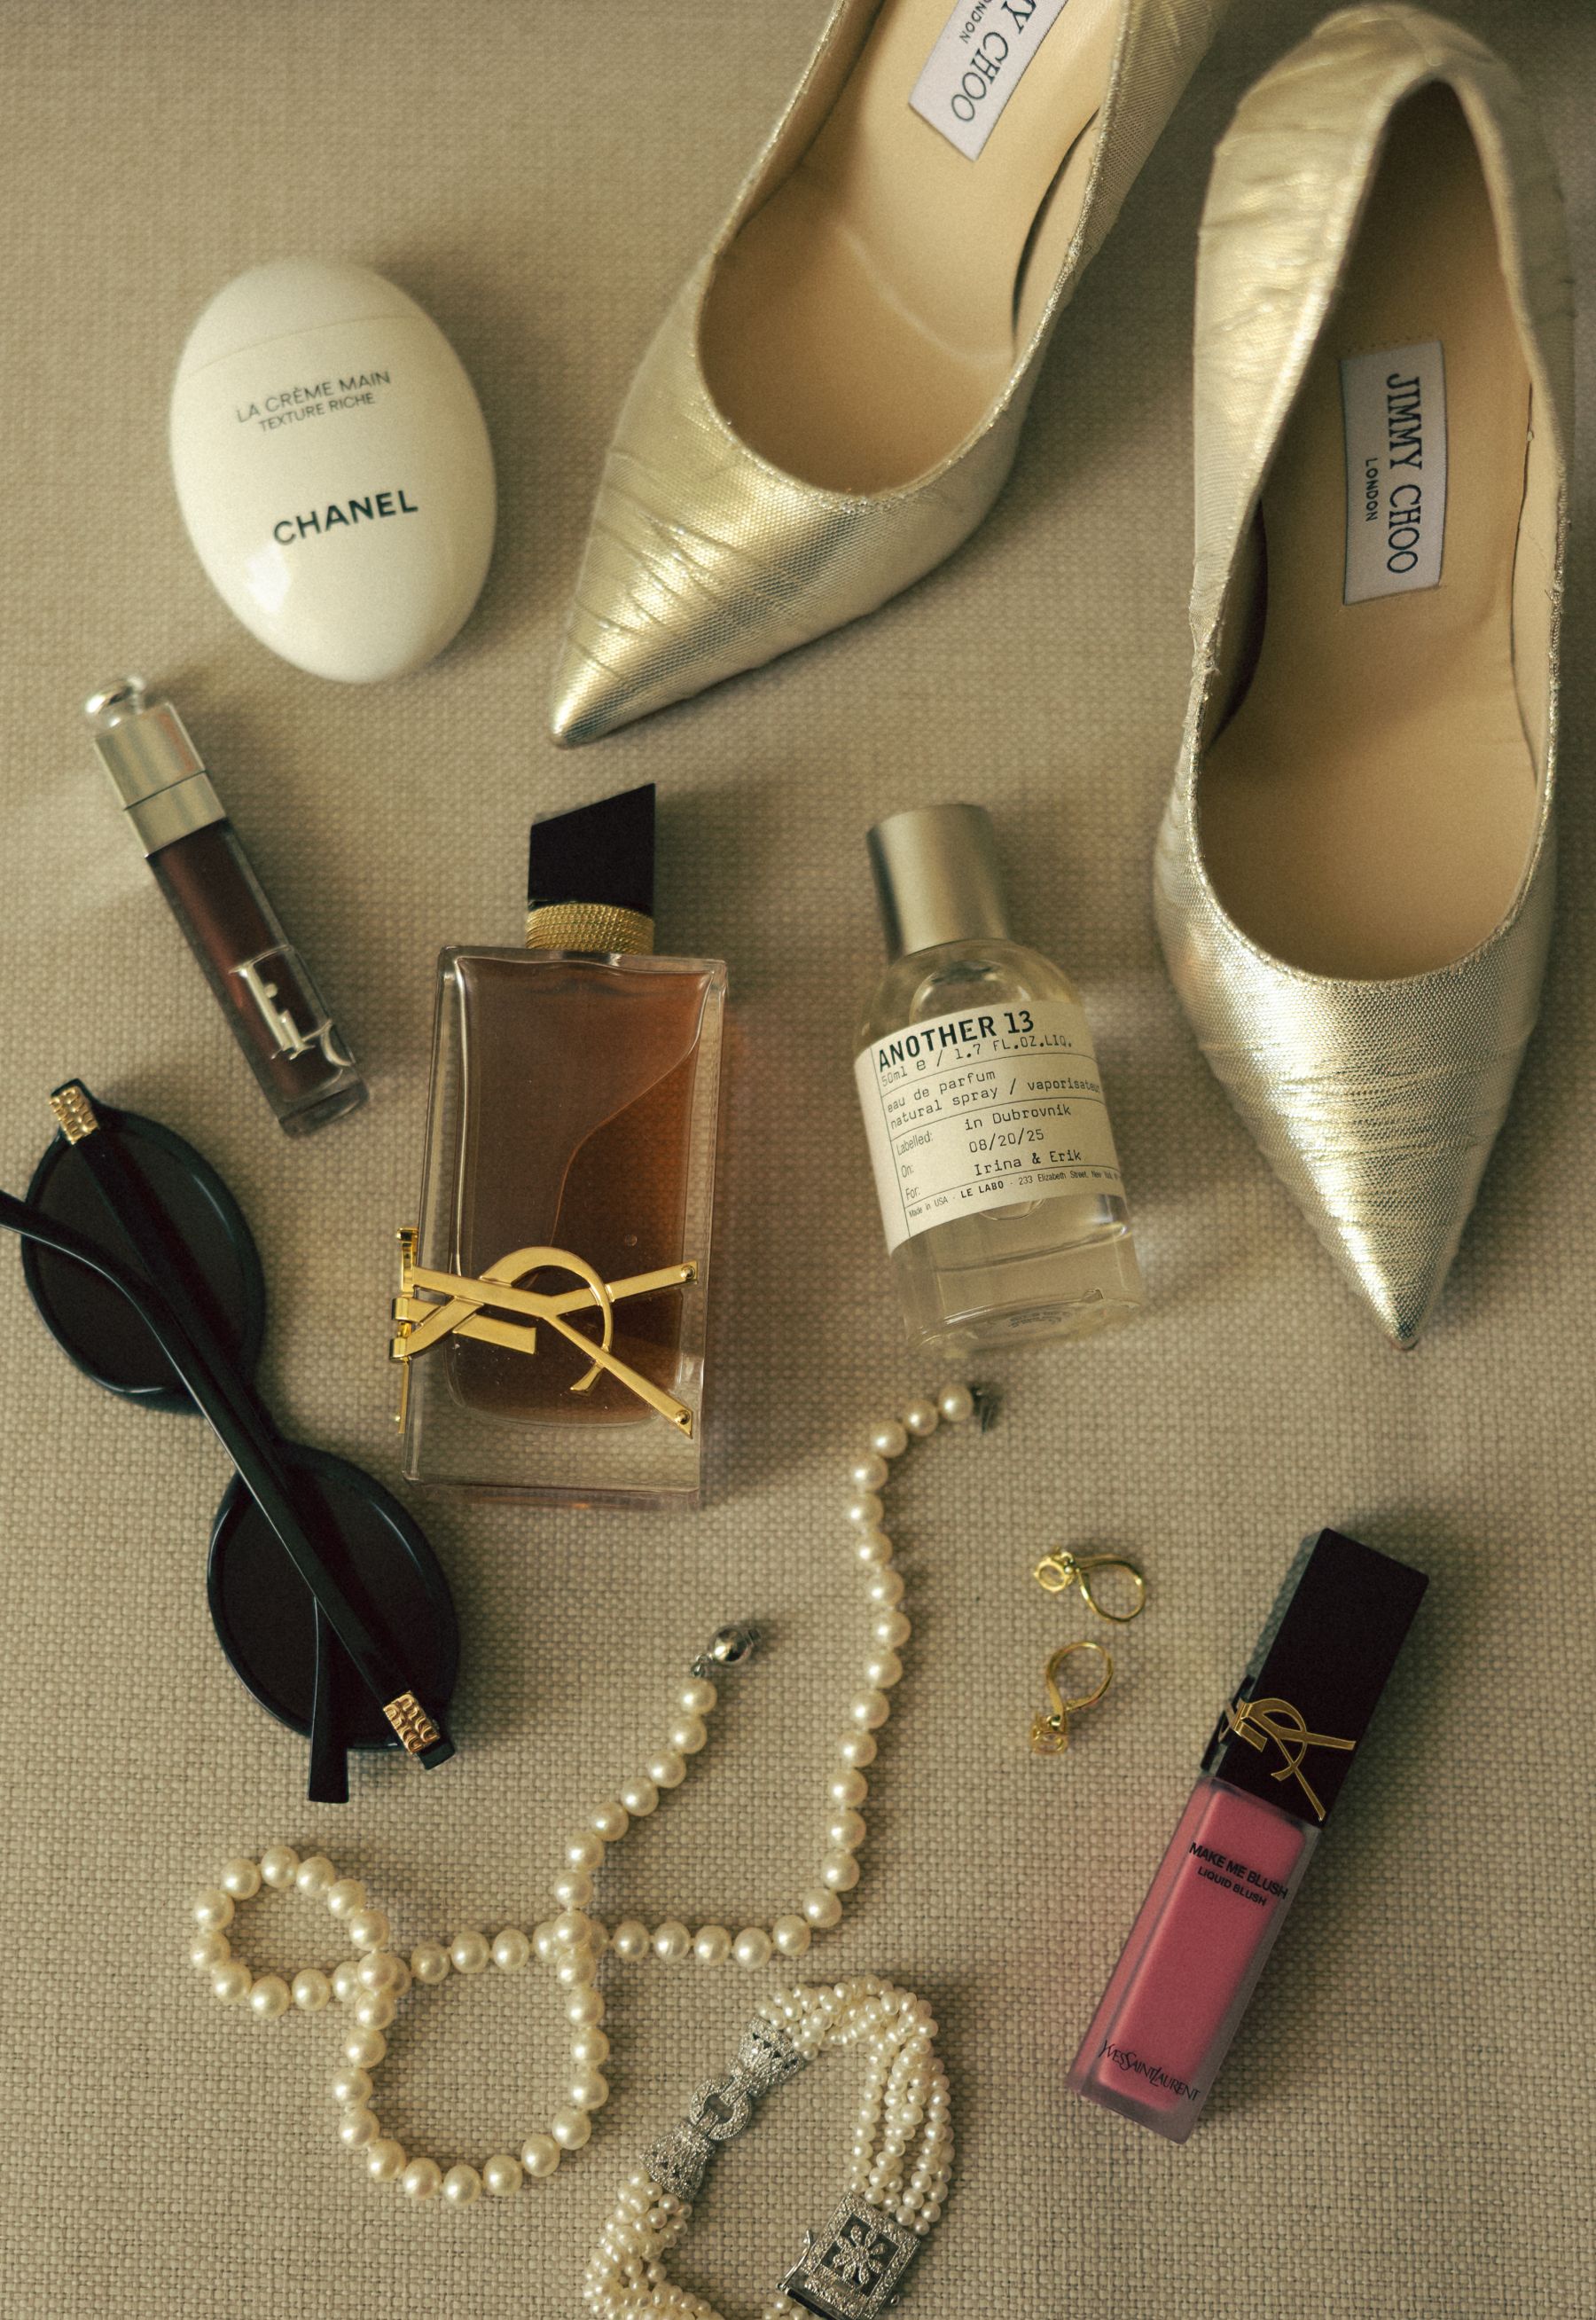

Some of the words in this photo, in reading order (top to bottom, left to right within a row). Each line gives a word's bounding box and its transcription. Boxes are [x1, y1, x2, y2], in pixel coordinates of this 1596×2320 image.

[951, 32, 1009, 121] CHOO
[237, 404, 262, 423] LA
[266, 381, 334, 412] CRÈME
[339, 371, 391, 393] MAIN
[259, 404, 325, 432] TEXTURE
[329, 392, 376, 412] RICHE
[1386, 372, 1422, 469] JIMMY
[1365, 458, 1379, 521] LONDON
[273, 490, 419, 545] CHANEL
[1387, 484, 1421, 573] CHOO
[879, 1016, 997, 1072] ANOTHER
[1004, 1010, 1034, 1033] 13
[881, 1066, 908, 1087] 50ml
[955, 1043, 981, 1060] 1.7
[888, 1097, 905, 1113] eau
[913, 1088, 929, 1101] de
[939, 1070, 996, 1094] parfum
[890, 1100, 942, 1130] natural
[952, 1087, 998, 1106] spray
[896, 1130, 933, 1156] Labelled:
[965, 1118, 982, 1131] in
[992, 1104, 1071, 1124] Dubrovnik
[901, 1164, 914, 1178] On:
[969, 1128, 1044, 1153] 08/20/25
[974, 1157, 1021, 1176] Irina
[1032, 1153, 1041, 1164] &
[1049, 1149, 1082, 1163] Erik
[908, 1206, 923, 1218] Made
[934, 1196, 949, 1207] USA
[960, 1188, 974, 1198] LE
[978, 1180, 1004, 1194] LABO
[1019, 1175, 1033, 1185] 233
[1037, 1172, 1067, 1182] Elizabeth
[1189, 1842, 1226, 1868] MAKE
[1226, 1861, 1247, 1878] ME
[1247, 1870, 1288, 1900] BLUSH
[1198, 1866, 1232, 1888] LIQUID
[1232, 1884, 1267, 1907] BLUSH
